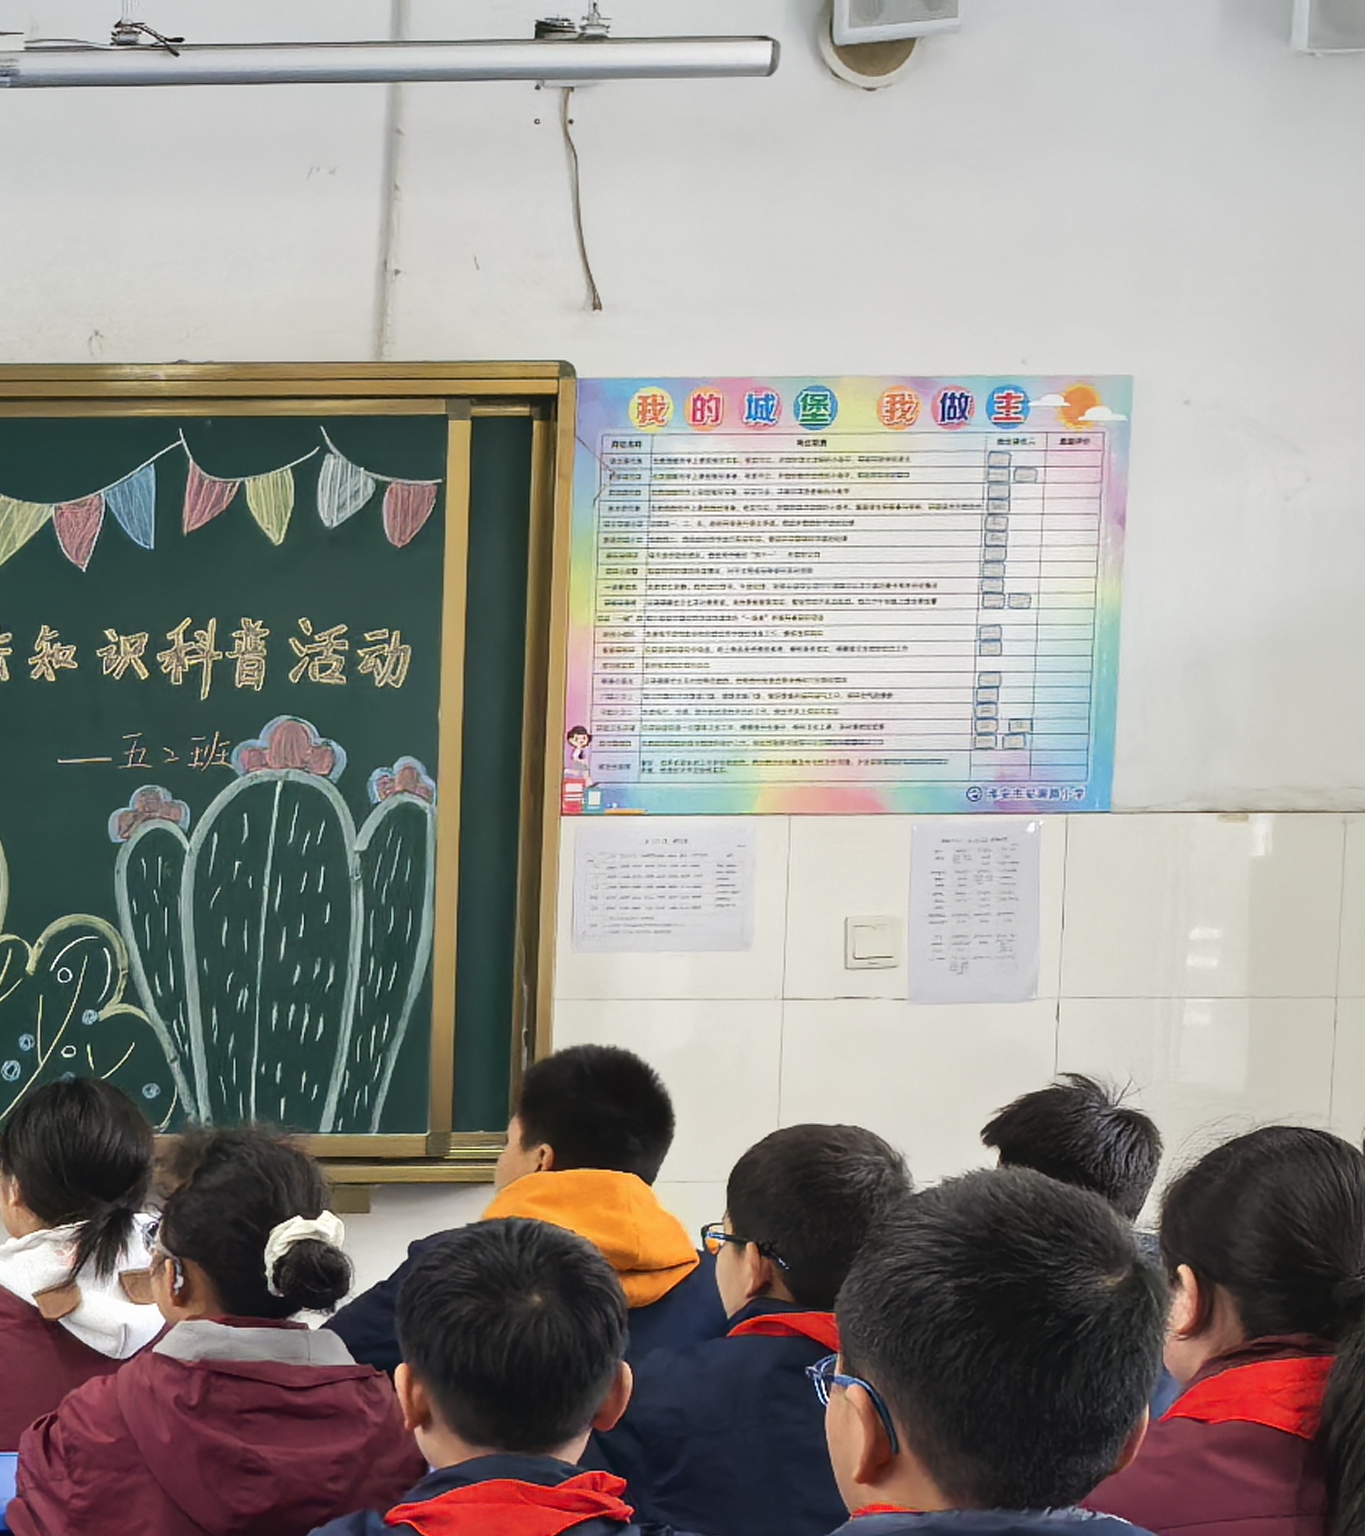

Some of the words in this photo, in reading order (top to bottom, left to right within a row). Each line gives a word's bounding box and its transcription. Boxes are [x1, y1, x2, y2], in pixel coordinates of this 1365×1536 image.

[635, 391, 834, 428] 我的城堡
[881, 389, 1024, 426] 我做主
